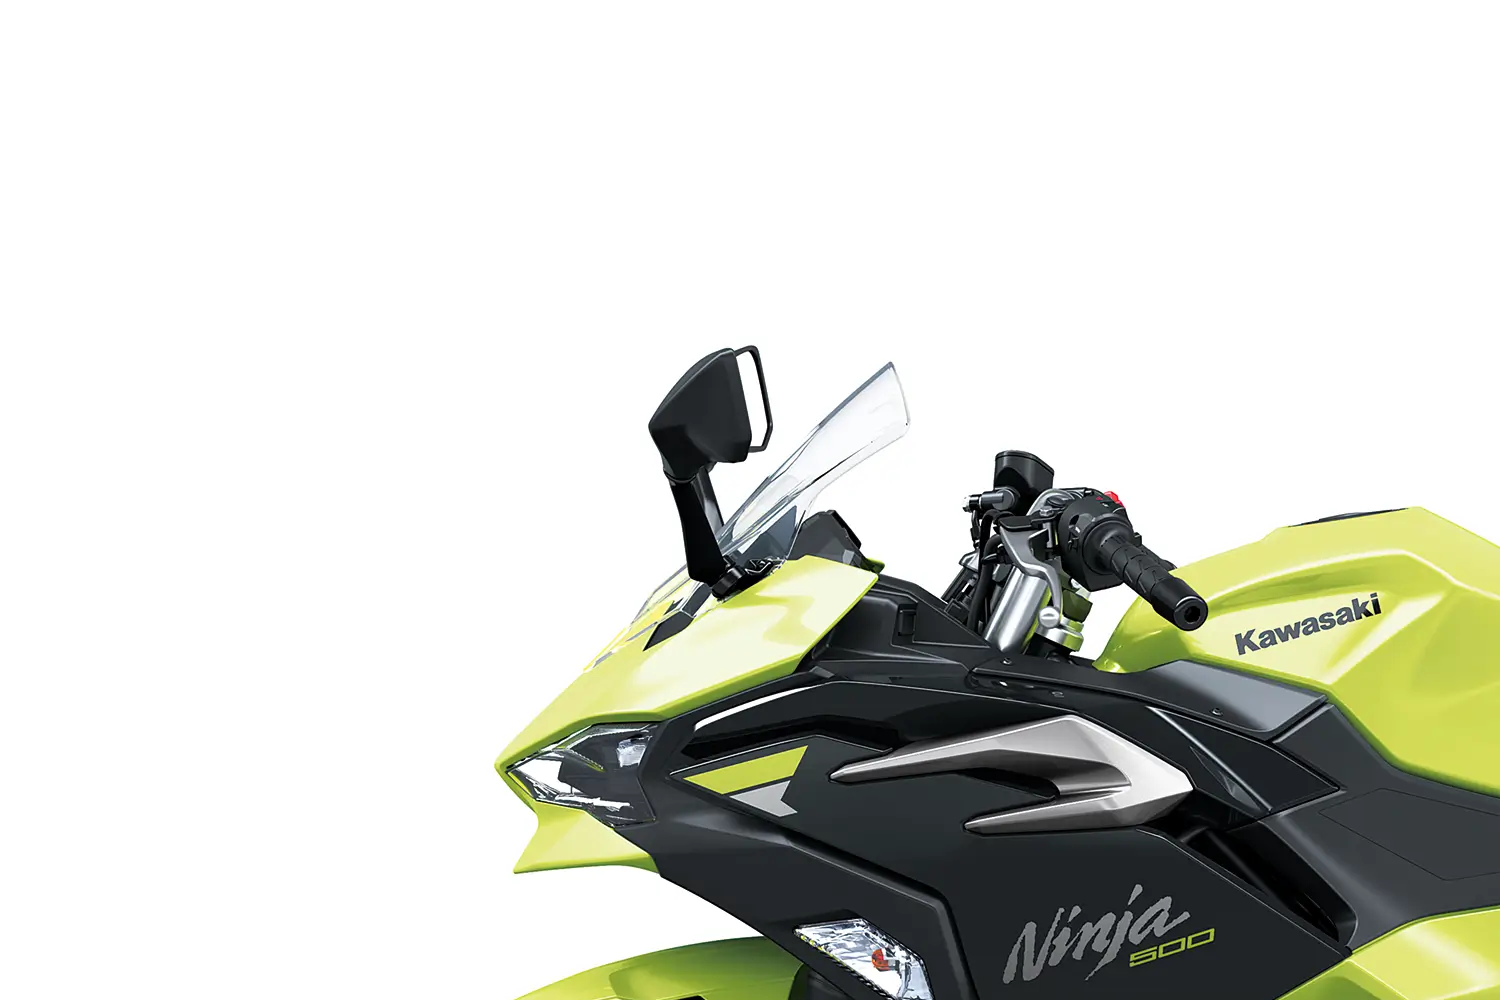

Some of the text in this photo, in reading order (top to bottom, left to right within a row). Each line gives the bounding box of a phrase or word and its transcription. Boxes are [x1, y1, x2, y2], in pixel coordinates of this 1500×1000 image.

[1234, 592, 1382, 656] Kawasaki
[1002, 883, 1191, 984] Ninja
[1129, 927, 1215, 968] 500
